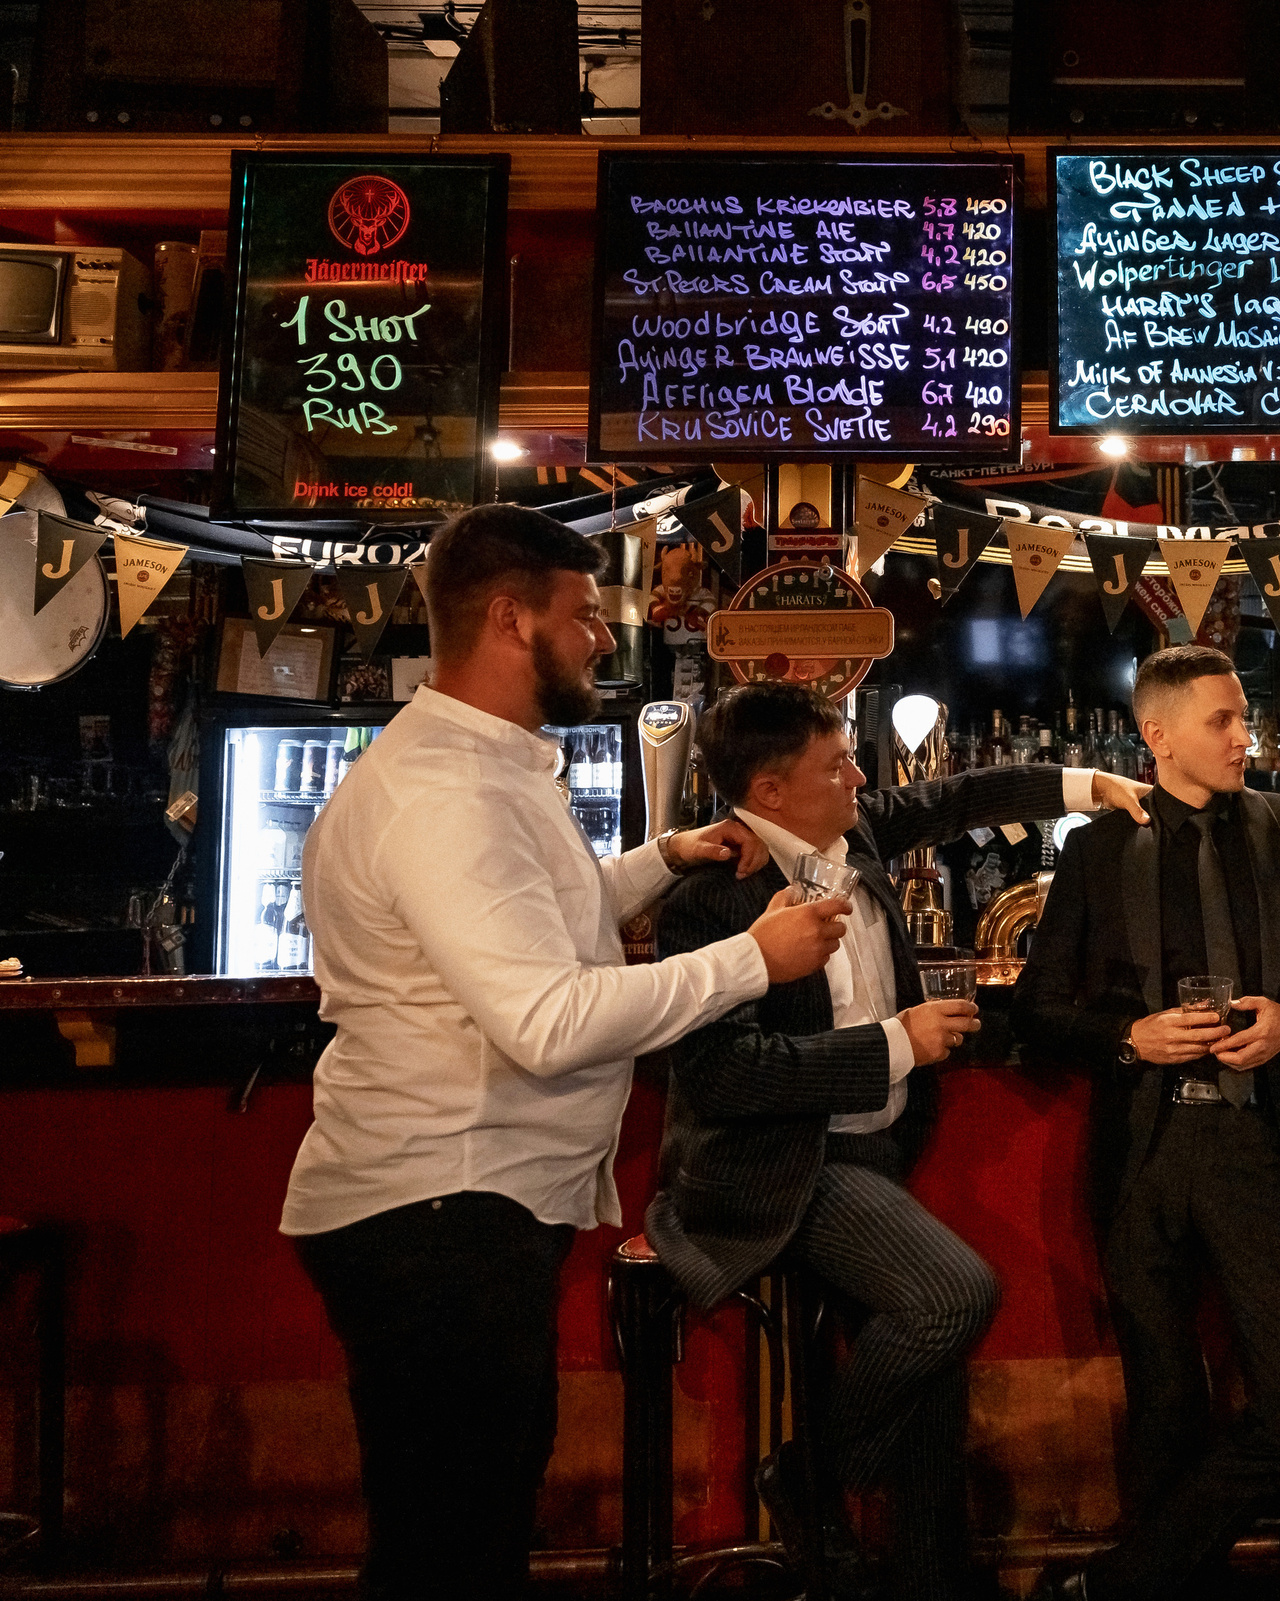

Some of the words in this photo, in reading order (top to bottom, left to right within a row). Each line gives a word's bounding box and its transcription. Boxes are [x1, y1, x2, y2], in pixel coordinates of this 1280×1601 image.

[1180, 158, 1266, 187] SHEEP
[966, 197, 1007, 215] 450
[963, 222, 1001, 240] 420
[963, 247, 1006, 266] 420
[964, 273, 1007, 291] 450
[1073, 255, 1254, 292] Wolpertinger
[280, 295, 310, 344] 1
[965, 316, 1008, 335] 490
[963, 346, 1008, 368] 420
[297, 353, 402, 392] 390
[1138, 360, 1164, 384] OF
[965, 381, 1002, 408] 420
[967, 412, 1010, 436] 290
[294, 482, 339, 497] Drink
[344, 482, 368, 497] ice
[373, 482, 413, 497] cold!
[865, 502, 907, 522] JAMESON
[707, 511, 735, 553] J
[42, 539, 74, 579] J
[272, 535, 432, 569] EURO2
[943, 528, 969, 568] J
[1016, 544, 1059, 557] JAMESON
[123, 559, 168, 574] JAMESON
[1103, 554, 1129, 594] J
[1173, 559, 1217, 570] JAMESON
[257, 578, 285, 620] J
[356, 583, 383, 625] J
